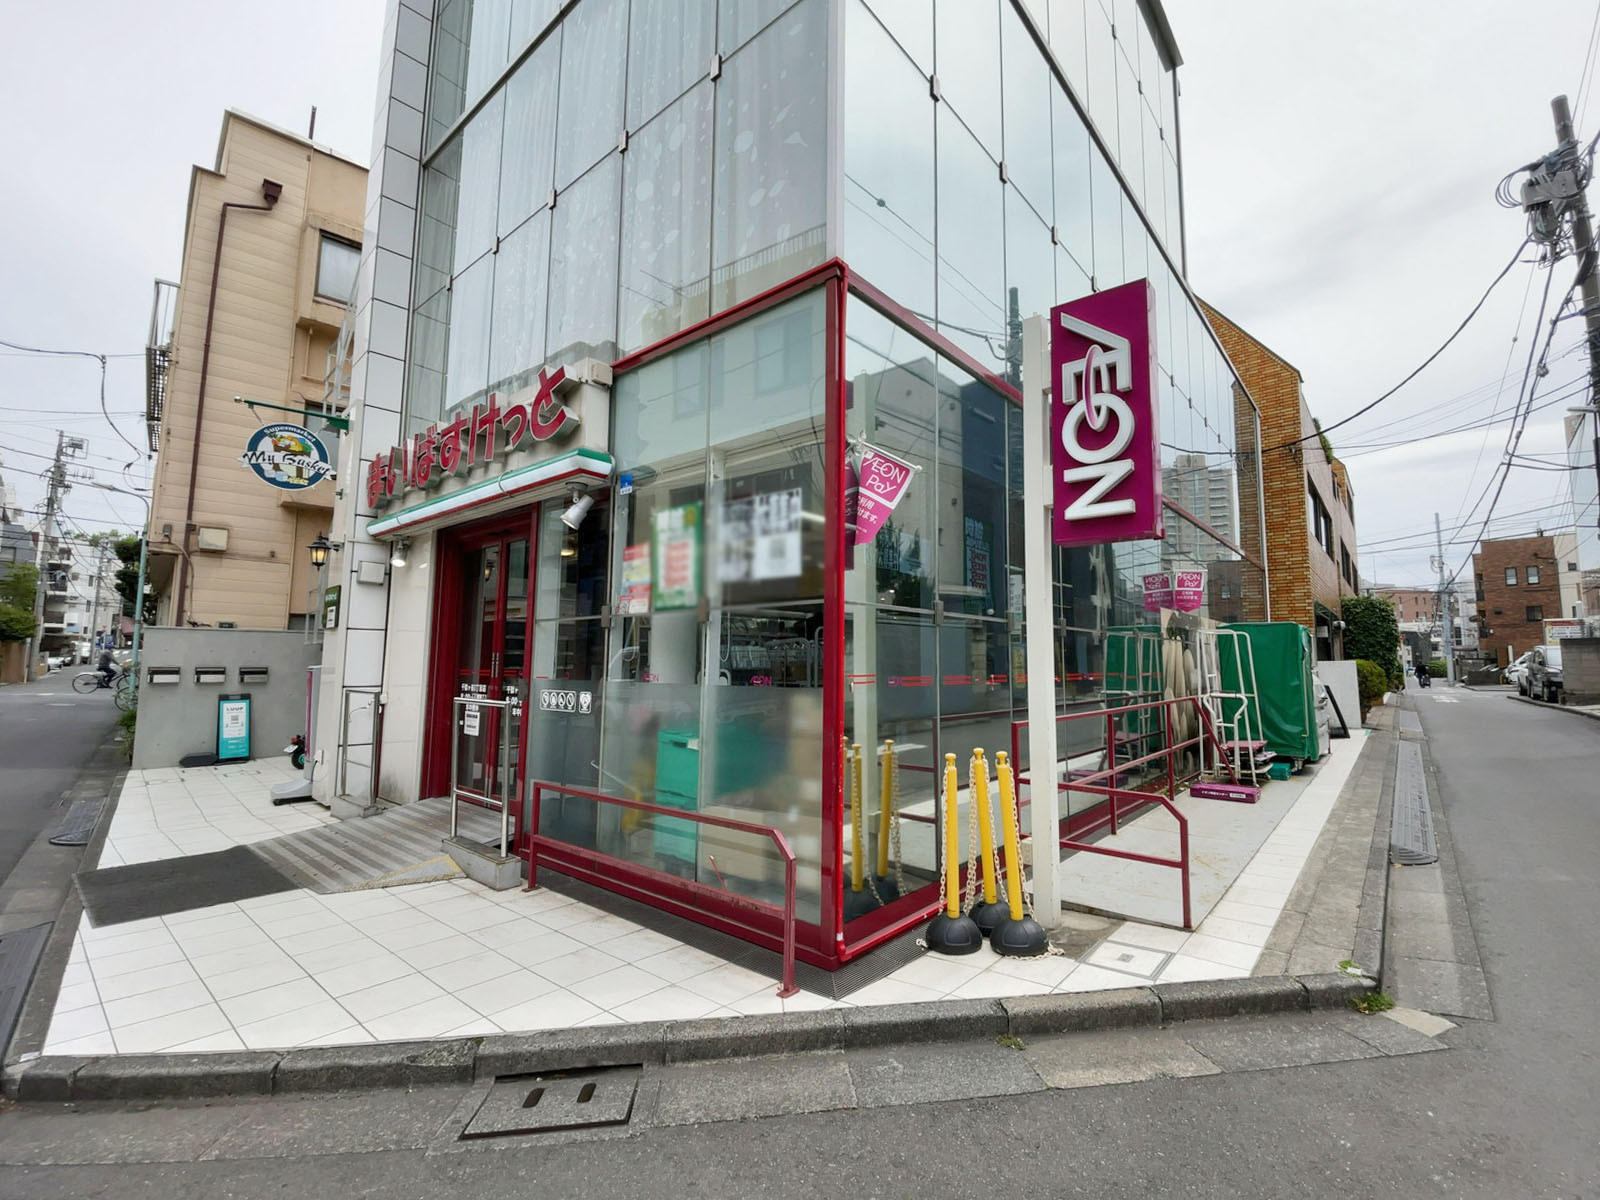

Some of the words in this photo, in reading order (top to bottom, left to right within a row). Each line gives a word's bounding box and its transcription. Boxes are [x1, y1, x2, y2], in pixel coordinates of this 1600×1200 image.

[1061, 312, 1137, 521] AEON
[263, 424, 317, 443] Supermarket
[367, 365, 567, 509] まいばすけっと
[242, 450, 275, 466] My
[282, 453, 331, 475] Basket
[863, 457, 906, 484] AEON
